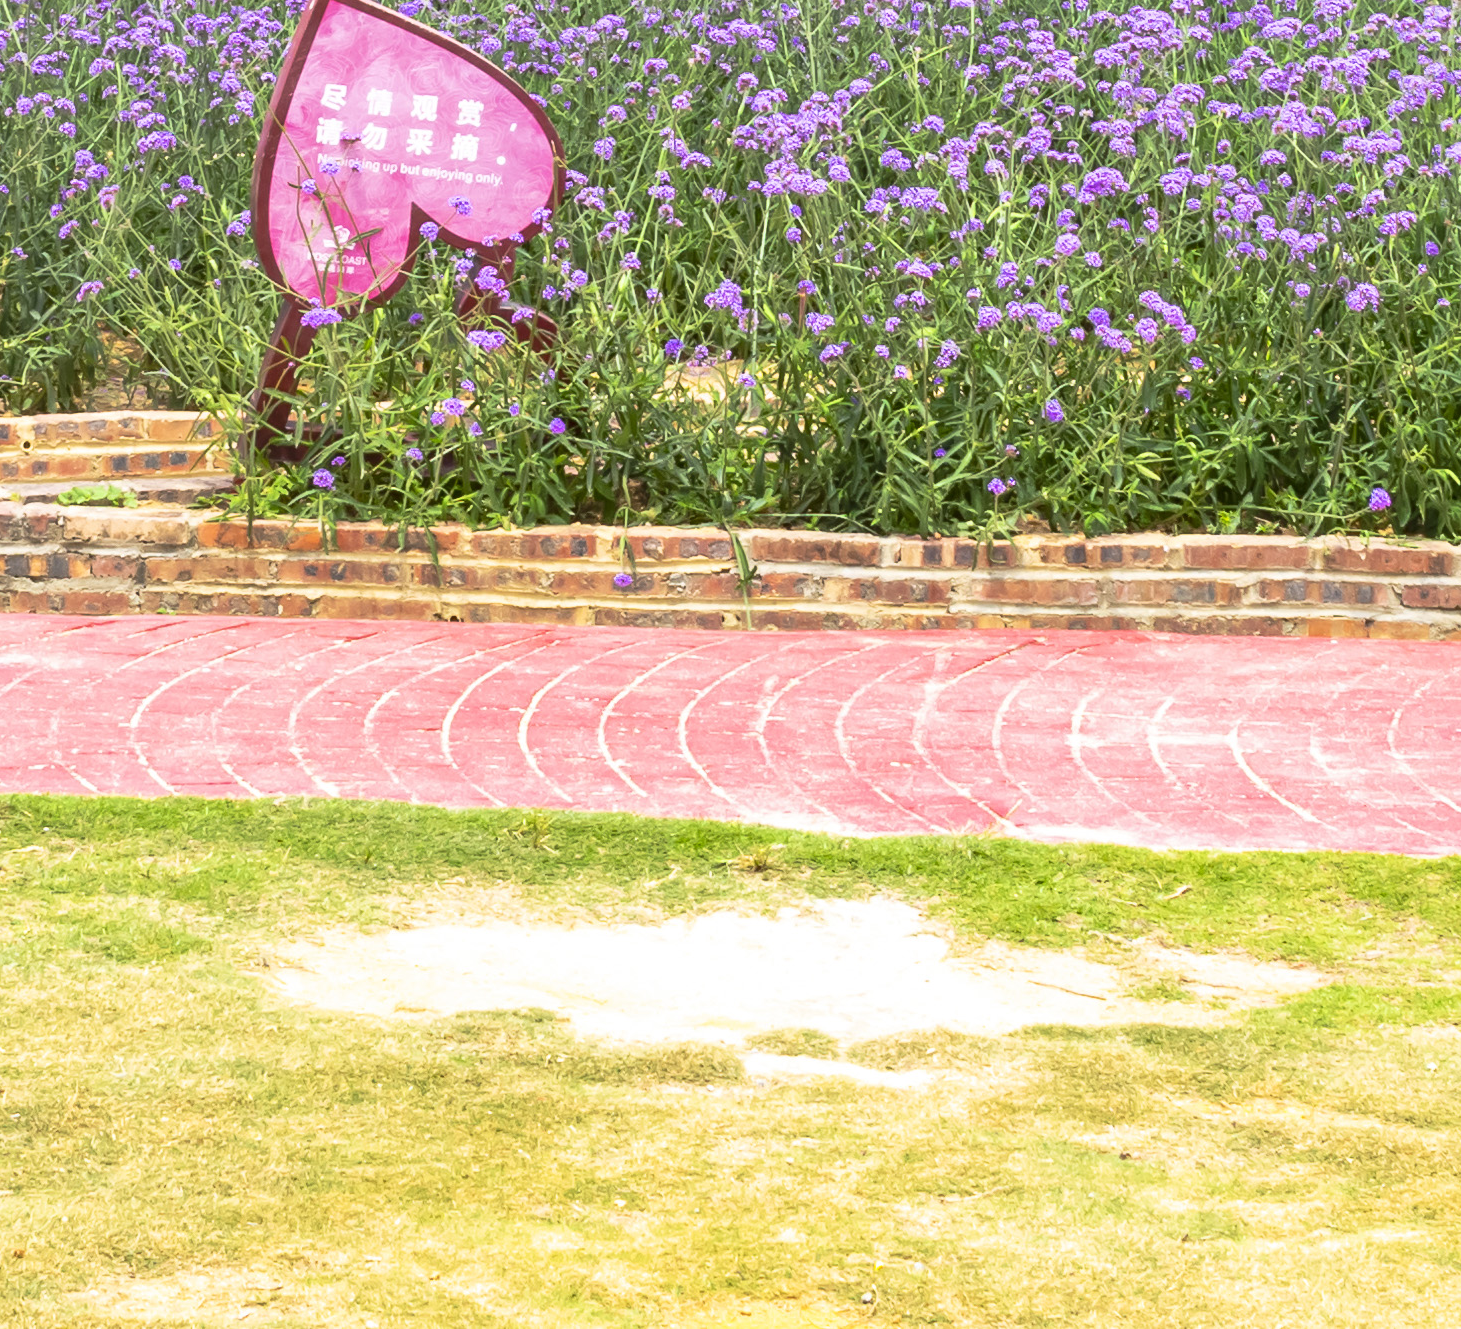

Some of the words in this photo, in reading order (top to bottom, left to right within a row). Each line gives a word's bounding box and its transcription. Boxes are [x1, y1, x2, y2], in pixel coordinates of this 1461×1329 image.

[382, 163, 398, 174] up
[400, 163, 421, 176] but
[422, 166, 473, 184] enjoying
[475, 173, 504, 187] only.
